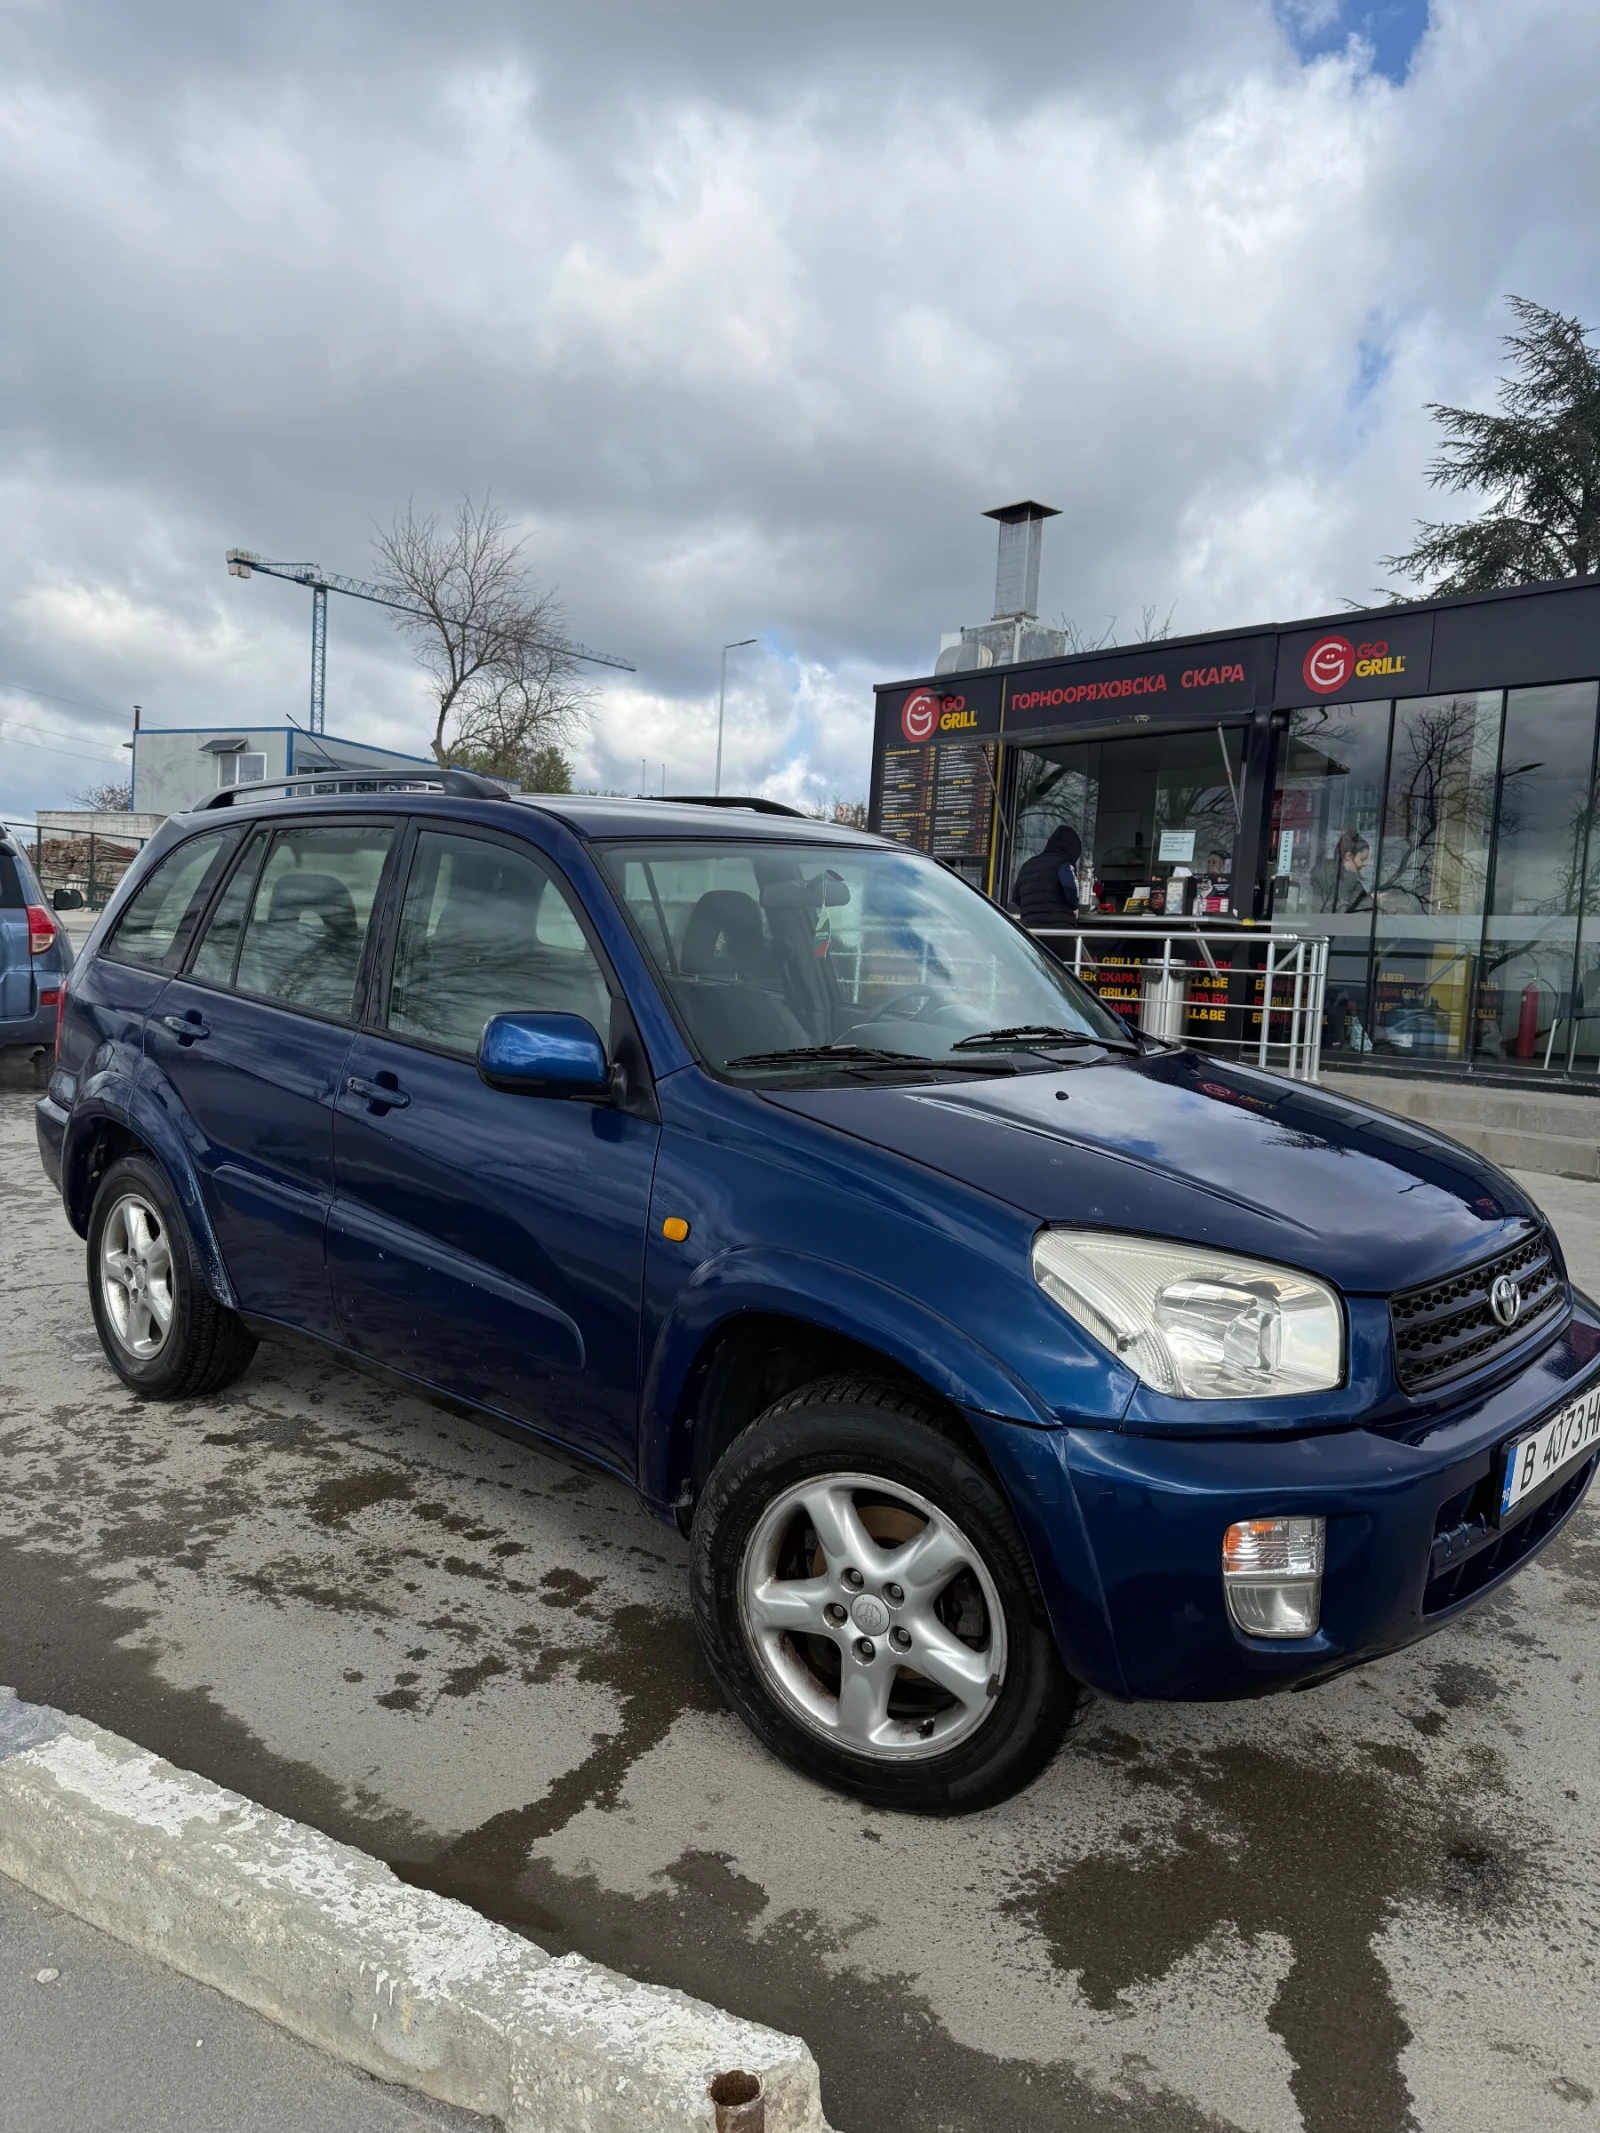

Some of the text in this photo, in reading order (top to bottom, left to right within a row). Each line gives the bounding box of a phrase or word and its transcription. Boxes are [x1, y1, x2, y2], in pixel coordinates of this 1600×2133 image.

[1357, 641, 1388, 659] GO
[1355, 655, 1405, 677] GRILL
[1011, 663, 1245, 711] ГОРНООРЯХОВСКА СКАРА
[941, 695, 966, 713] GO
[940, 710, 978, 731] GRILL
[1520, 1441, 1537, 1492] B
